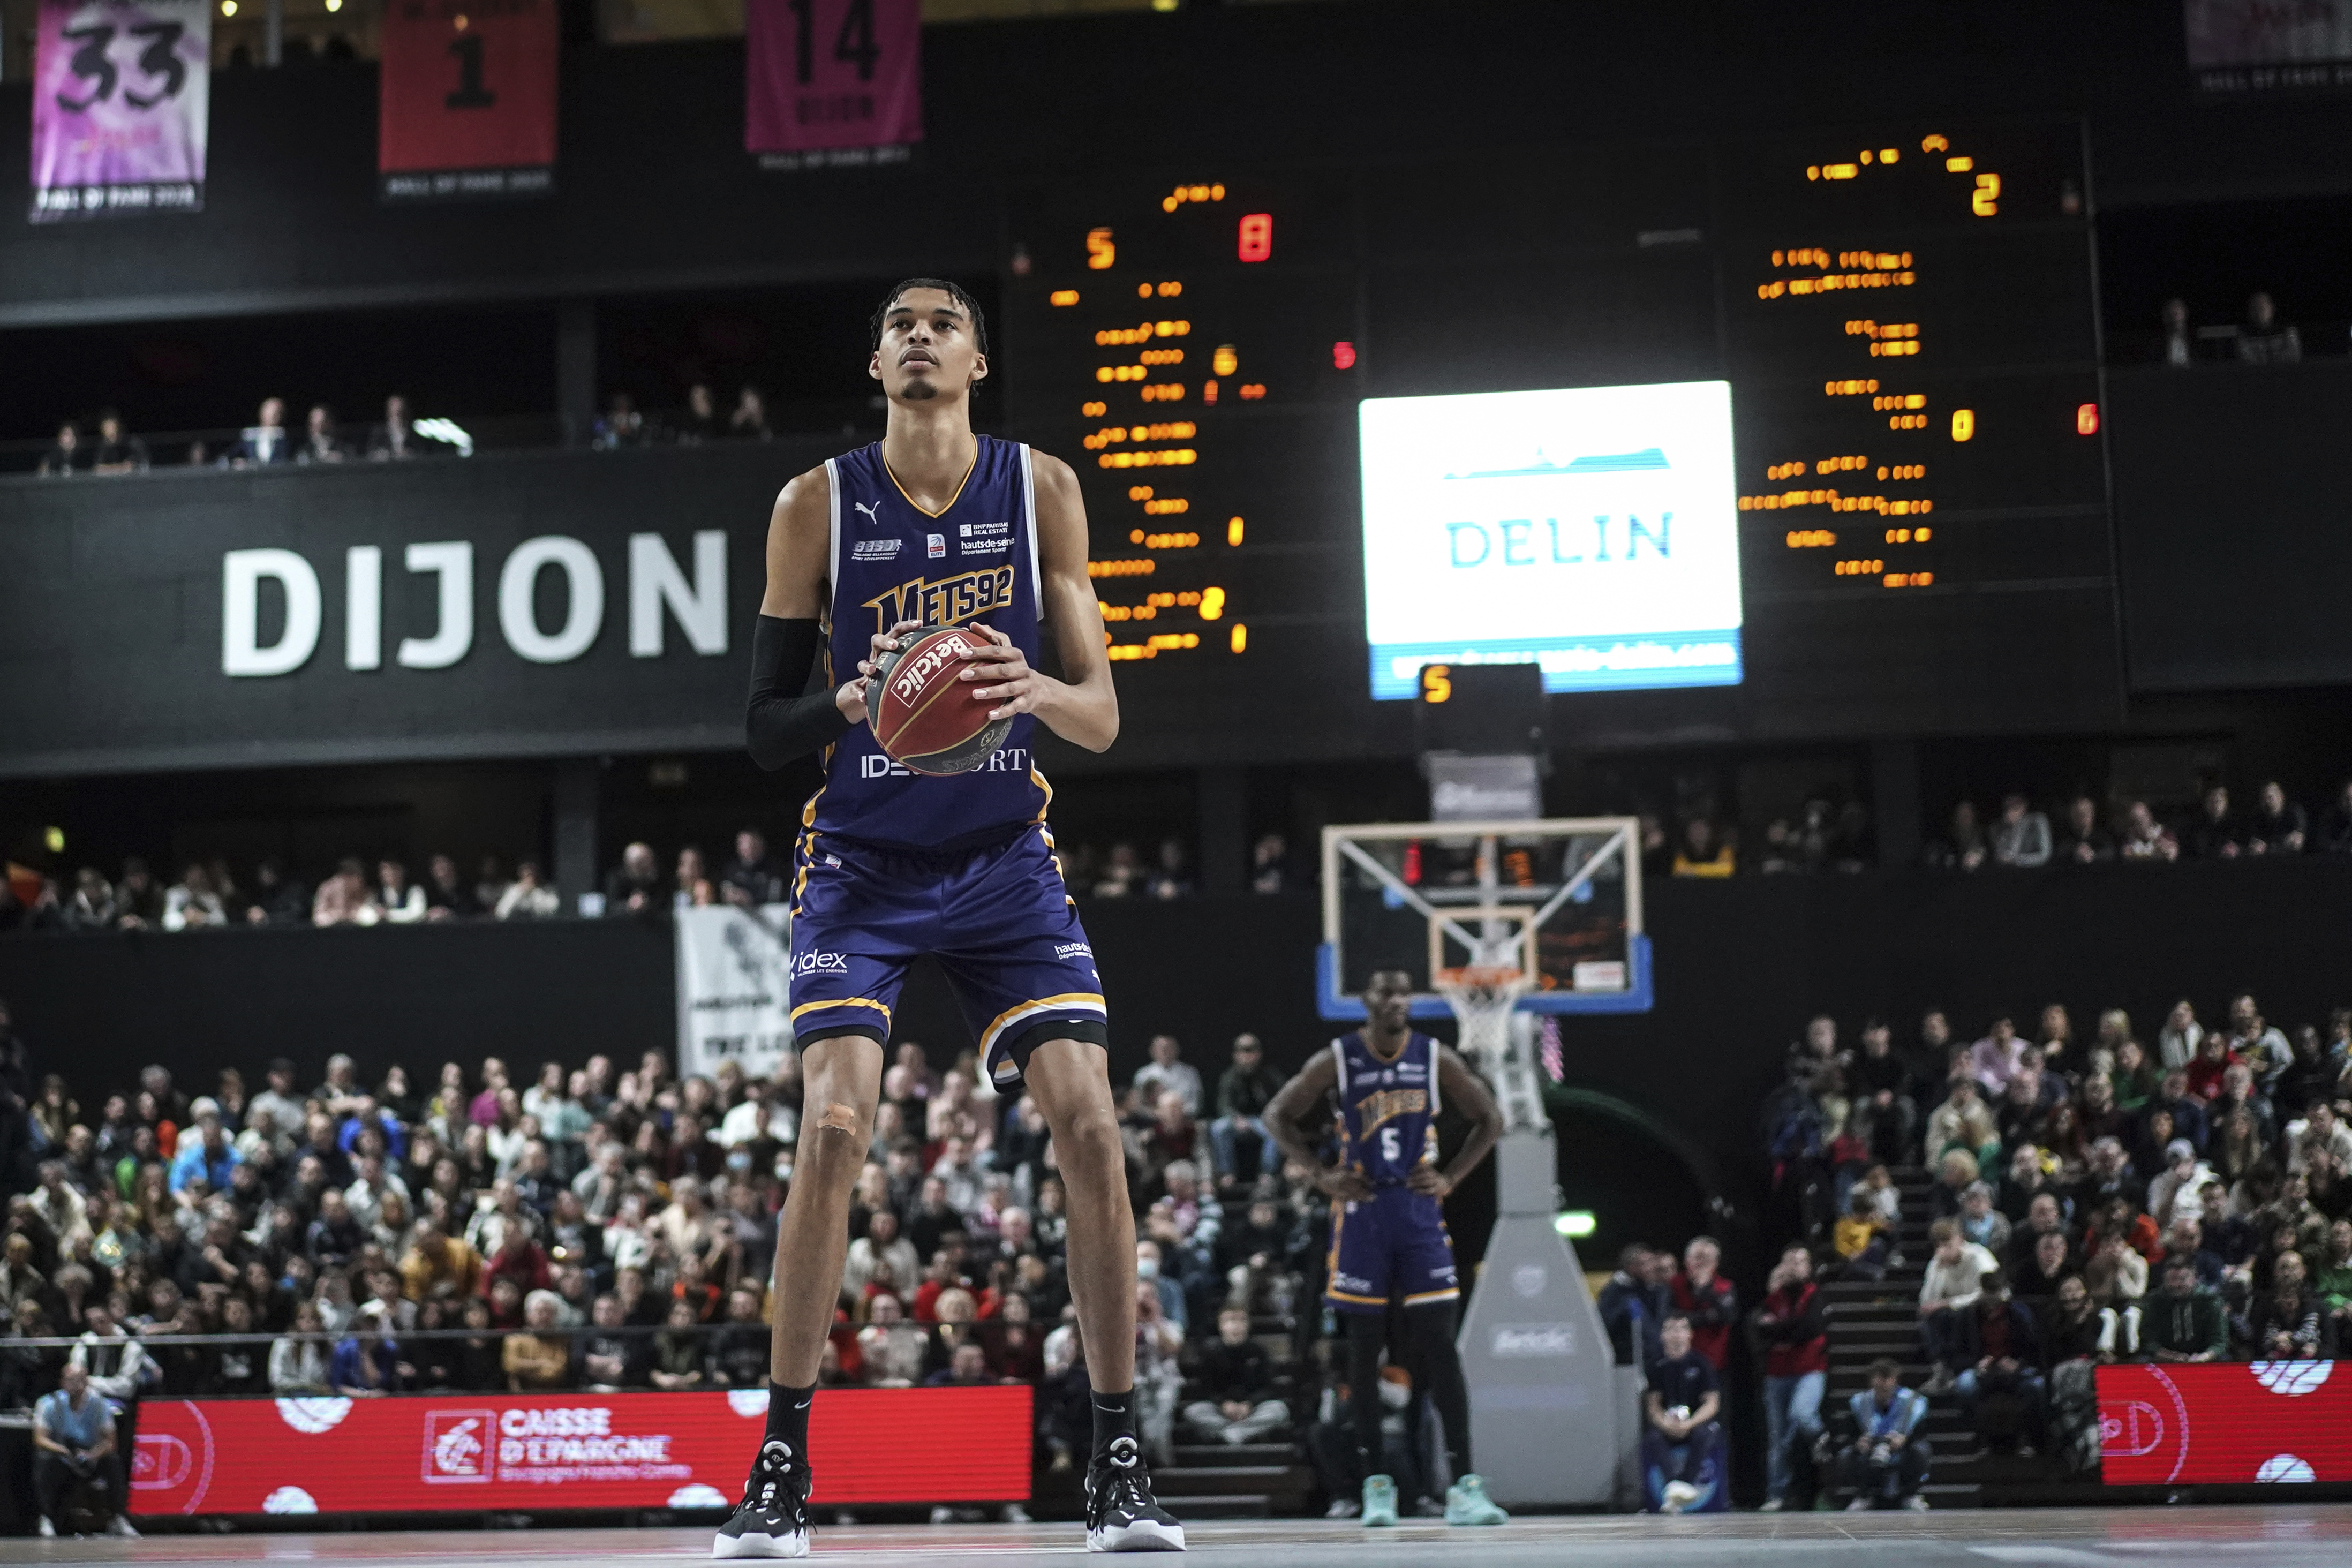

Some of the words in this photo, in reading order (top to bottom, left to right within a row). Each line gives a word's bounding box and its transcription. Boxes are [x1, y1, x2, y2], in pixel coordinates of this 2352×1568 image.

[55, 21, 186, 112] 33
[445, 33, 496, 109] 1
[1973, 173, 2000, 216] 2
[1087, 227, 1115, 269] 5
[1445, 512, 1673, 568] DELIN
[223, 530, 728, 677] DIJON
[860, 564, 1014, 634] METS92
[897, 636, 968, 698] Betclic
[1423, 664, 1451, 703] 5
[798, 948, 847, 973] idex
[1381, 1127, 1401, 1162] 5
[500, 1408, 612, 1436] CAISSE
